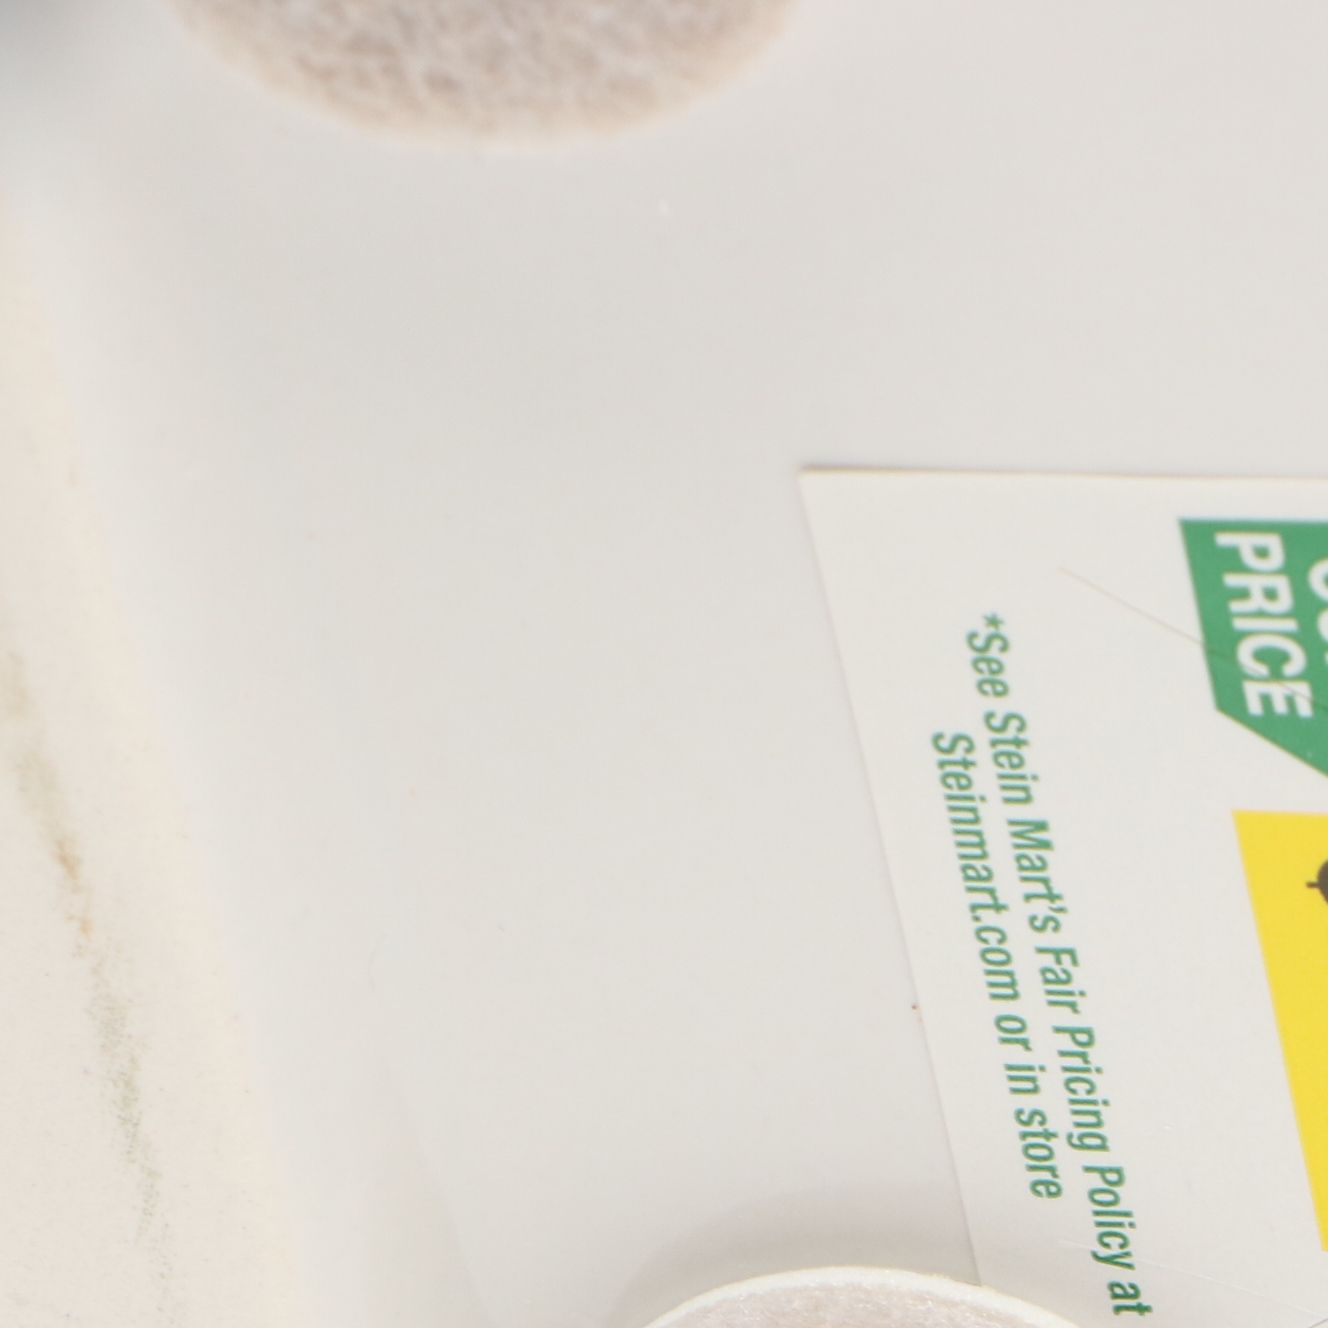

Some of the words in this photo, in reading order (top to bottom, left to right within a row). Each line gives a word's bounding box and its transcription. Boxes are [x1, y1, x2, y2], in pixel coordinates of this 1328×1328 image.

[1214, 532, 1313, 718] PRICE
[983, 710, 1040, 806] Stein
[932, 731, 1021, 1002] Steinmart.com
[1007, 818, 1069, 935] Mart's
[1035, 944, 1081, 1014] Fair
[994, 1014, 1034, 1052] or
[1004, 1061, 1047, 1097] in
[1052, 1021, 1111, 1153] Pricing
[1015, 1108, 1064, 1202] store
[1083, 1163, 1137, 1272] Policy
[1107, 1280, 1153, 1317] at
